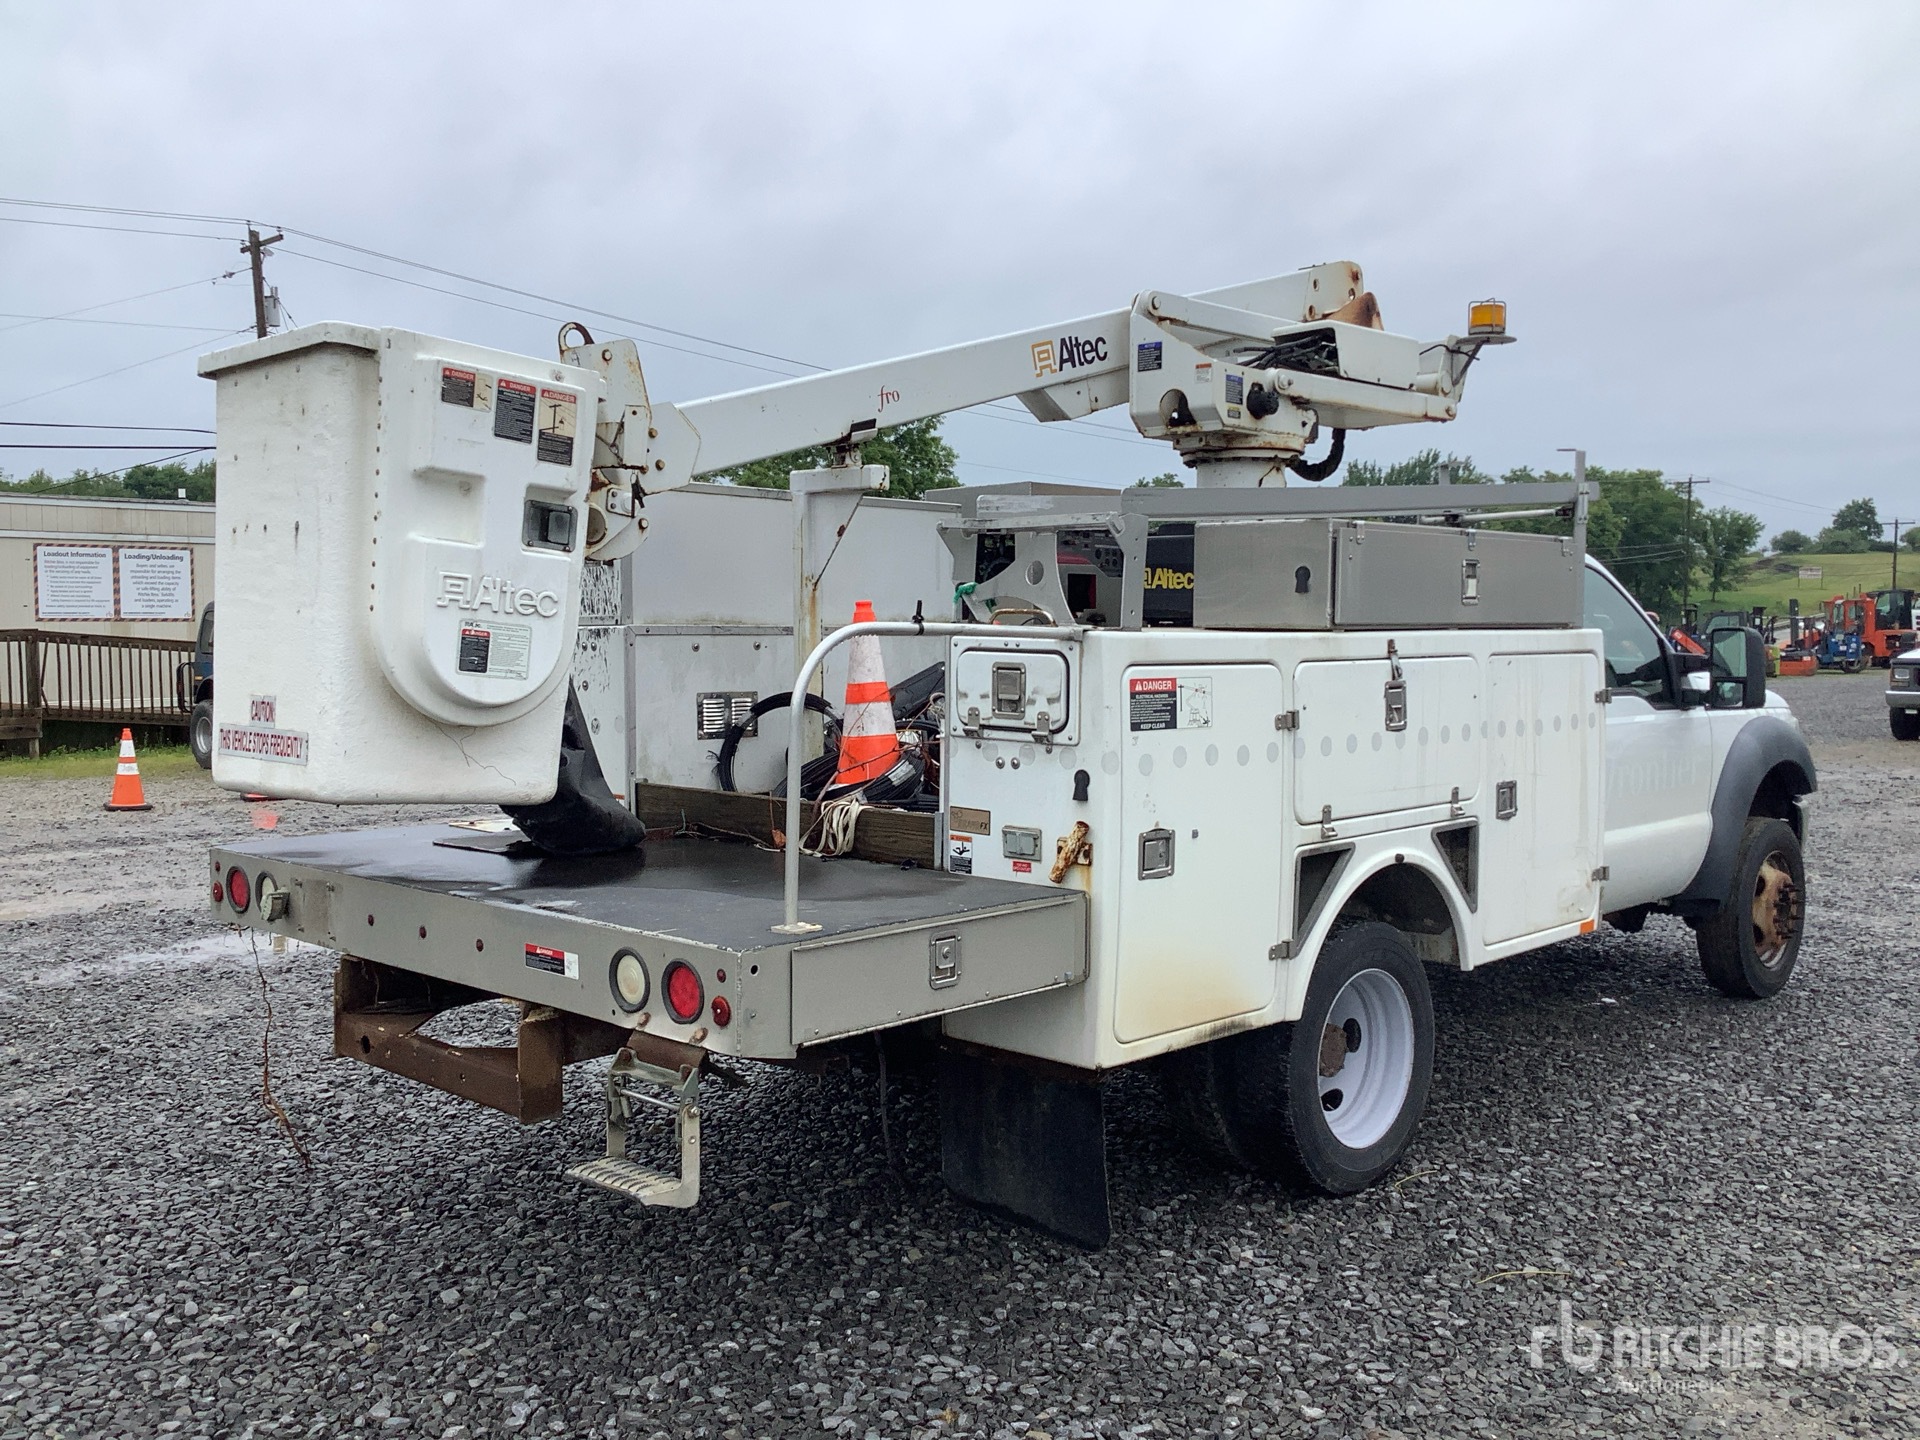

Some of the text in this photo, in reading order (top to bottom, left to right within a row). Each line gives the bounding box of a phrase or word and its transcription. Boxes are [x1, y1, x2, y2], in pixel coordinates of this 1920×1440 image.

[1059, 336, 1108, 372] Altec
[452, 370, 474, 380] DANGER
[509, 382, 531, 392] DANGER
[549, 392, 574, 403] DANGER
[877, 385, 900, 413] fro
[124, 553, 183, 562] Loading/Unloading
[1152, 568, 1194, 589] Altec
[471, 575, 558, 617] Altec
[1143, 681, 1172, 690] DANGER
[220, 729, 303, 758] THIS VEHICLE STOPS FREQUENTLY
[980, 822, 988, 830] FX
